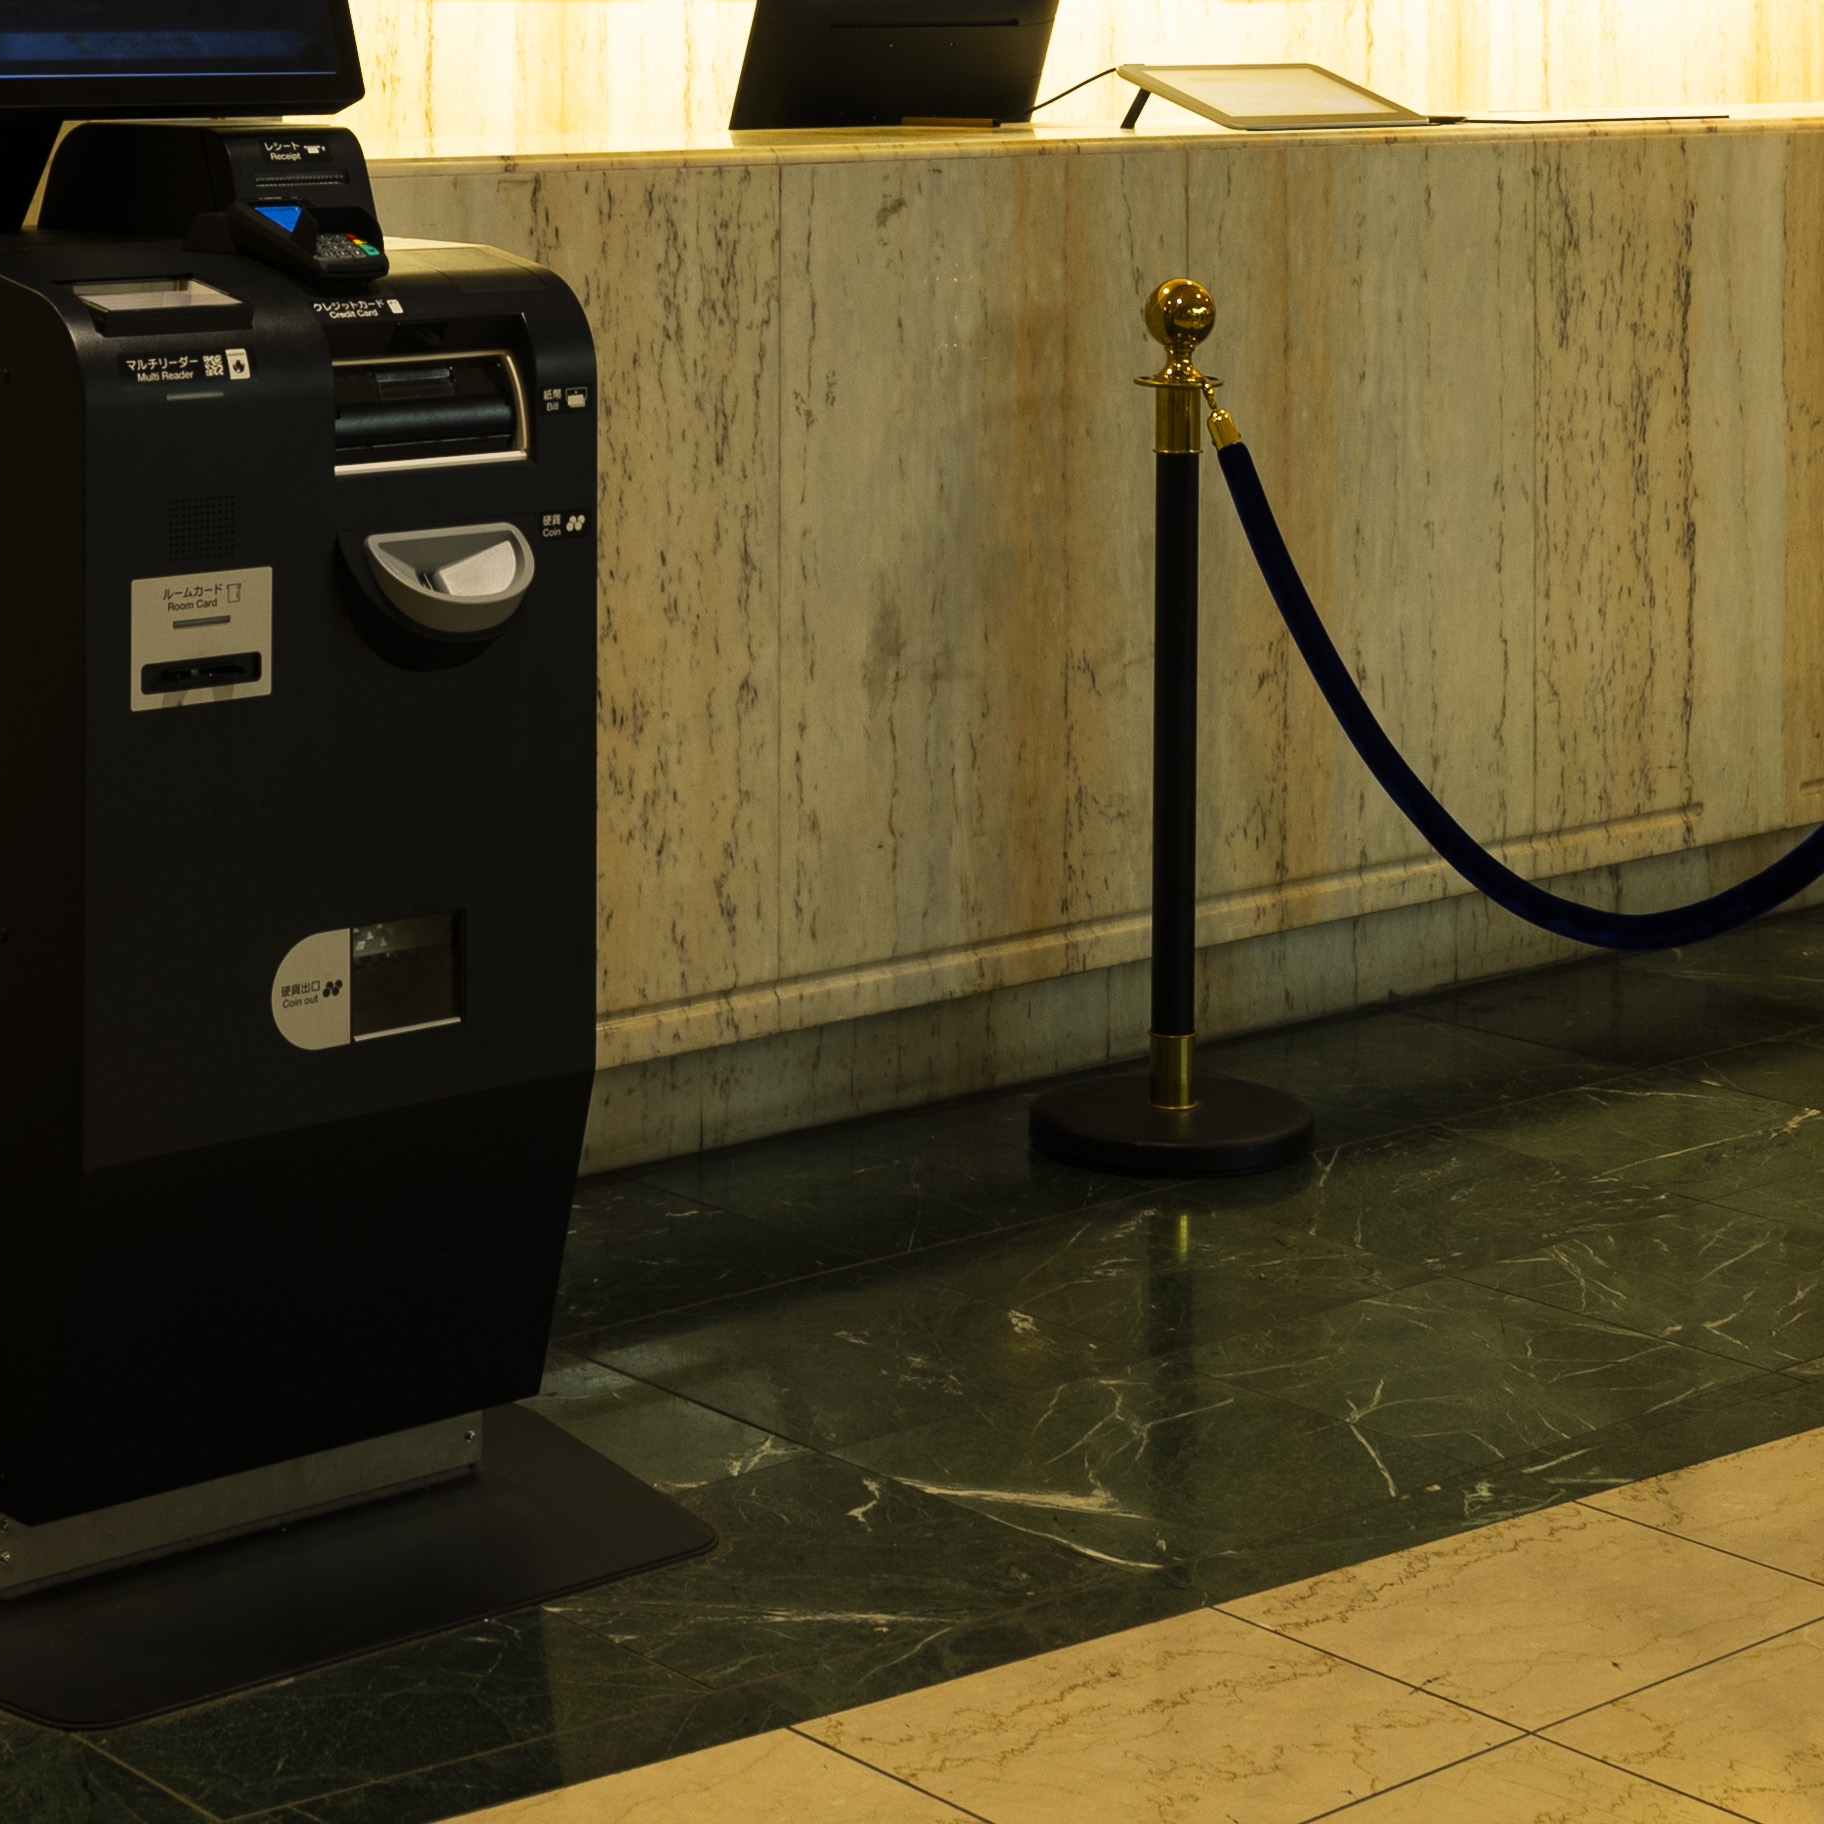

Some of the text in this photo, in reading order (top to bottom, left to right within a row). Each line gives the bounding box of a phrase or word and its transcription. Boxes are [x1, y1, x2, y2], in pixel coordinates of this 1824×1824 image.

[264, 141, 300, 152] レシート
[270, 152, 301, 162] Receipt
[313, 299, 385, 312] クレジットカード
[329, 308, 379, 319] Credit Card
[125, 356, 199, 371] マルチリーダー
[137, 370, 194, 382] Multi Reader
[542, 527, 562, 537] Coin
[163, 583, 223, 601] ルームカード
[167, 598, 218, 612] Room Card
[281, 980, 320, 996] 硬貨出口
[282, 994, 319, 1009] Coin out
